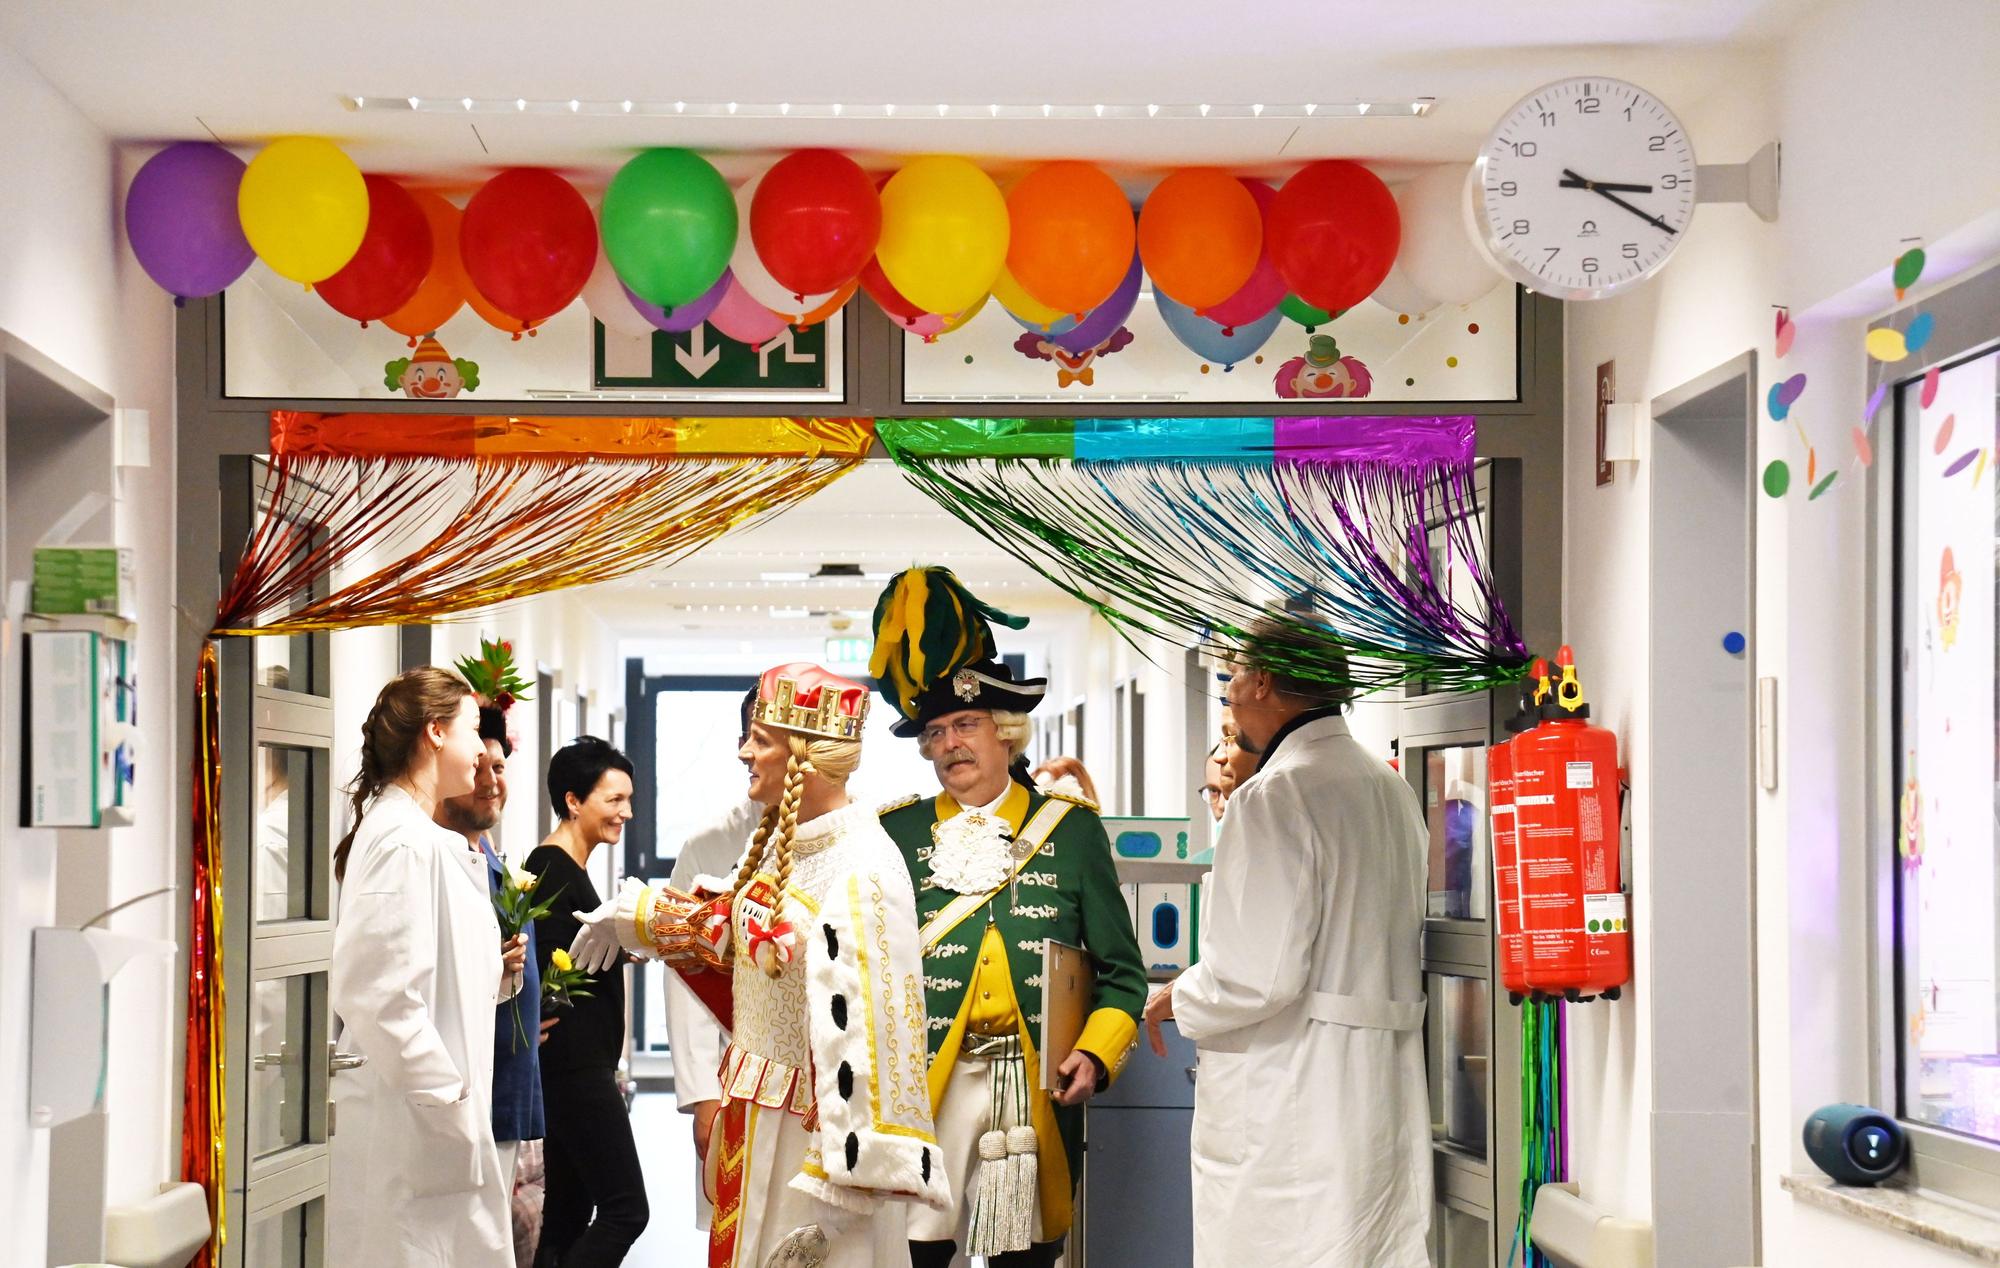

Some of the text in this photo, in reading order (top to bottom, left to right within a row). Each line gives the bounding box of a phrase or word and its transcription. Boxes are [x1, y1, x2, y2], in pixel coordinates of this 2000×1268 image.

[1574, 98, 1600, 113] 12
[1539, 111, 1556, 127] 11
[1623, 107, 1632, 122] 1
[1511, 142, 1537, 157] 10
[1648, 136, 1666, 151] 2
[1501, 182, 1518, 197] 9
[1661, 174, 1678, 190] 3
[1513, 219, 1530, 235] 8
[1543, 247, 1561, 263] 7
[1622, 243, 1639, 259] 5
[1582, 258, 1599, 273] 6
